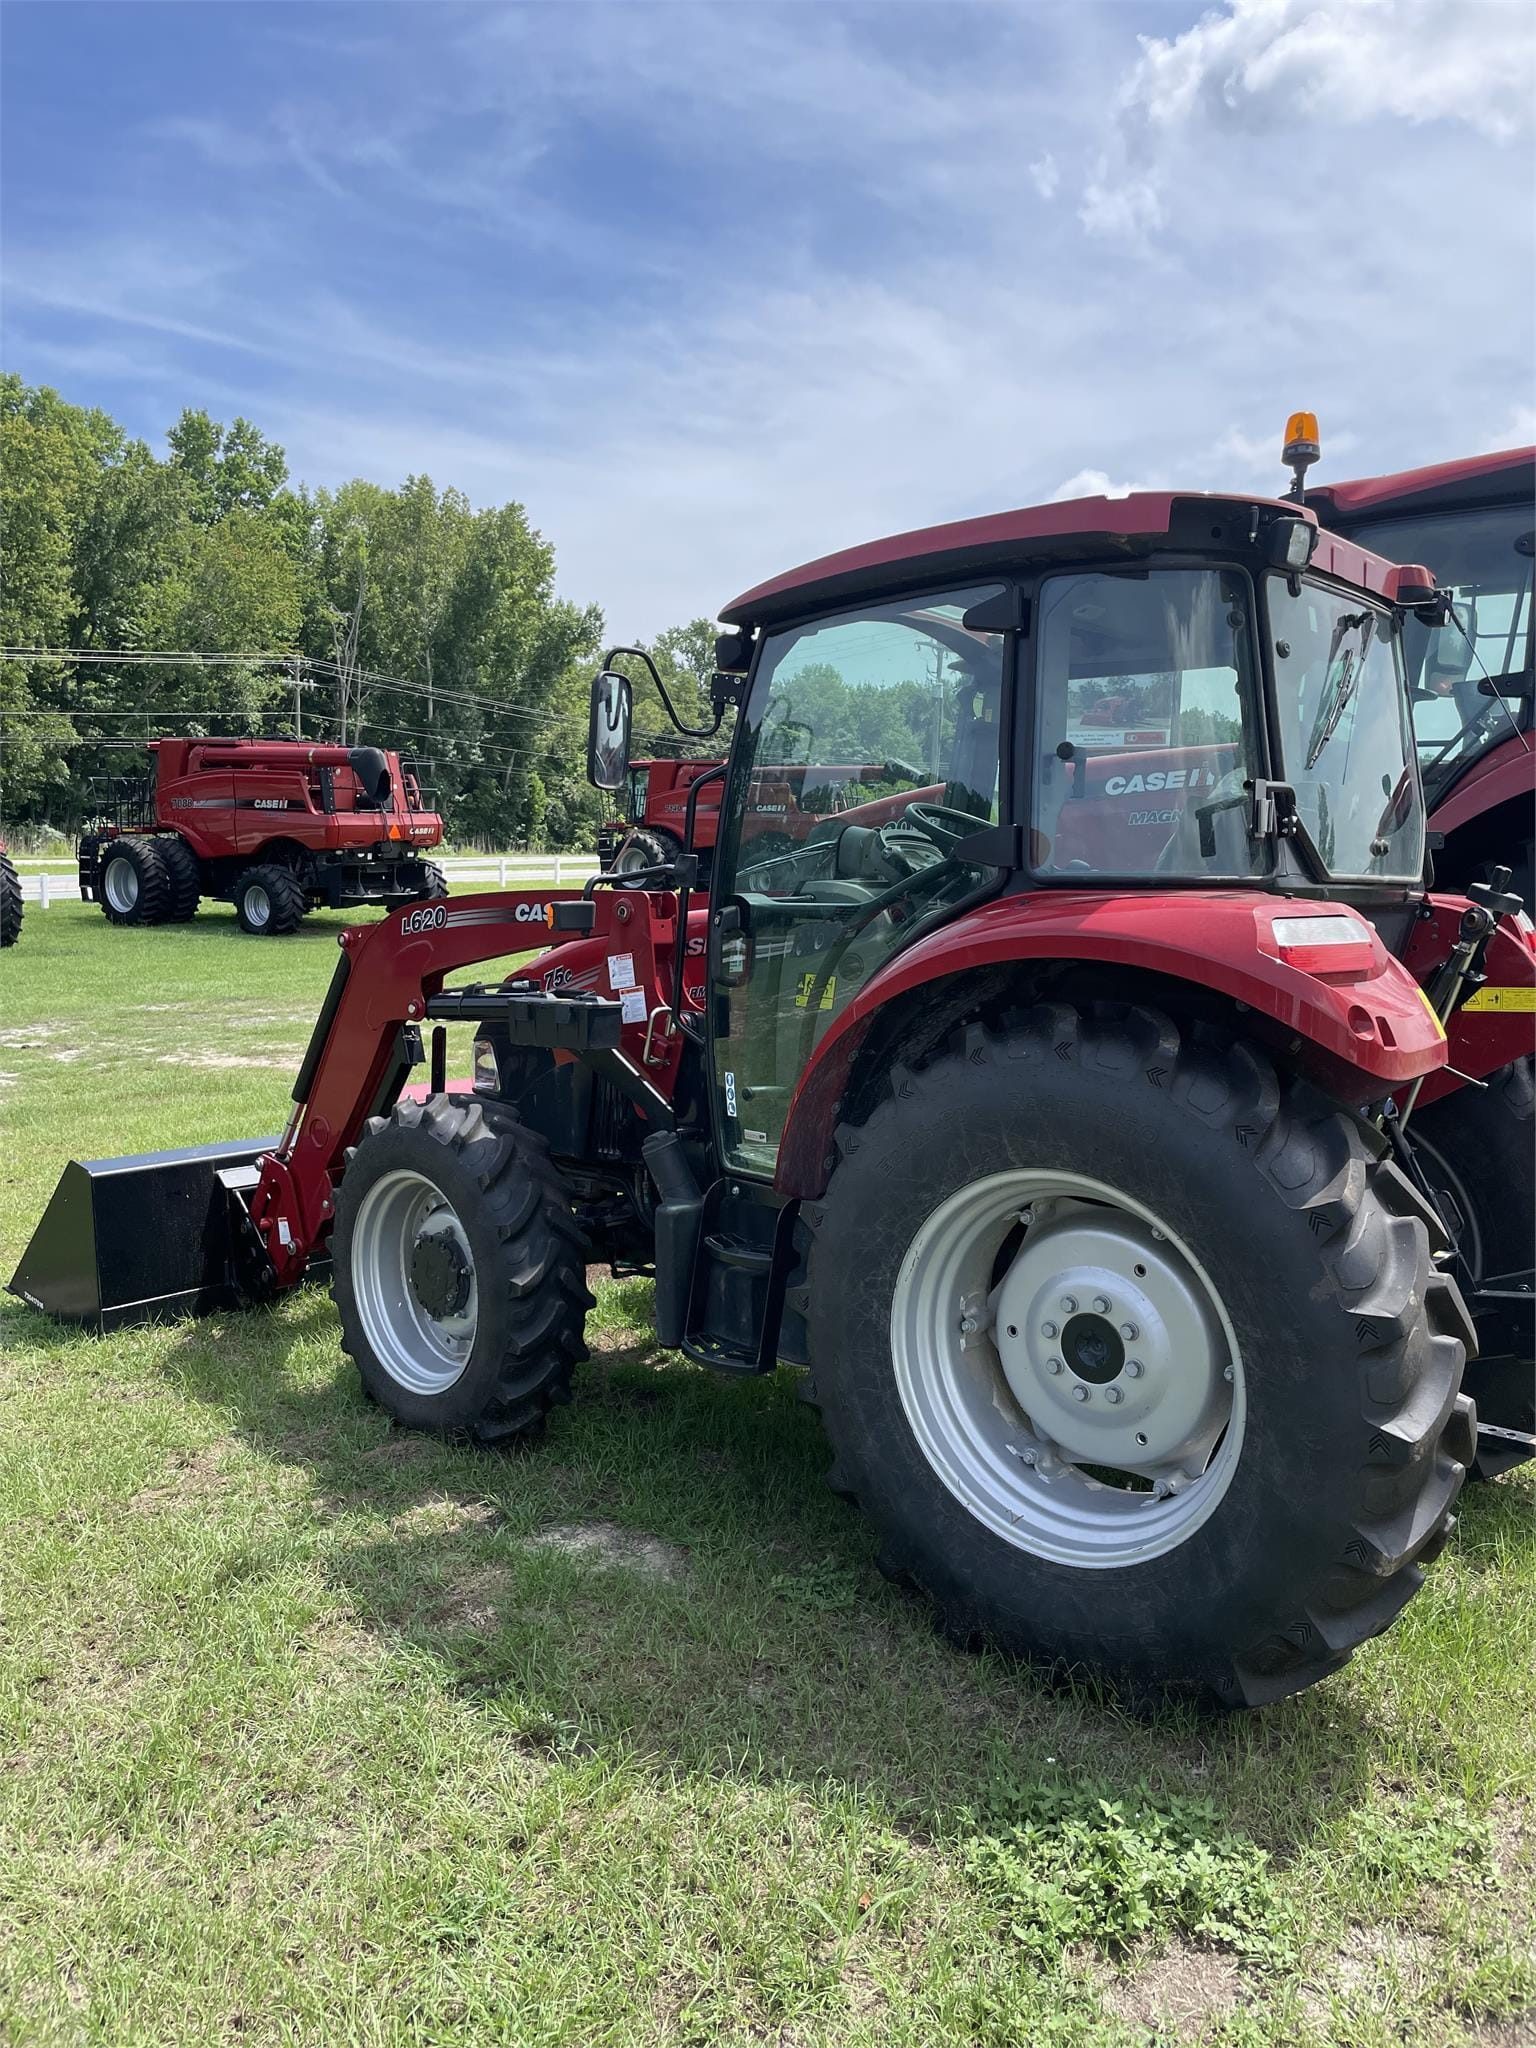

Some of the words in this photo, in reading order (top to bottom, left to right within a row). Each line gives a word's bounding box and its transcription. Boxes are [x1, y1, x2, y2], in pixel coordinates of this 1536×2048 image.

[1105, 769, 1187, 796] CASE
[254, 799, 279, 809] CASE
[756, 804, 777, 812] CASE
[409, 827, 428, 835] CASE
[402, 905, 447, 936] L620
